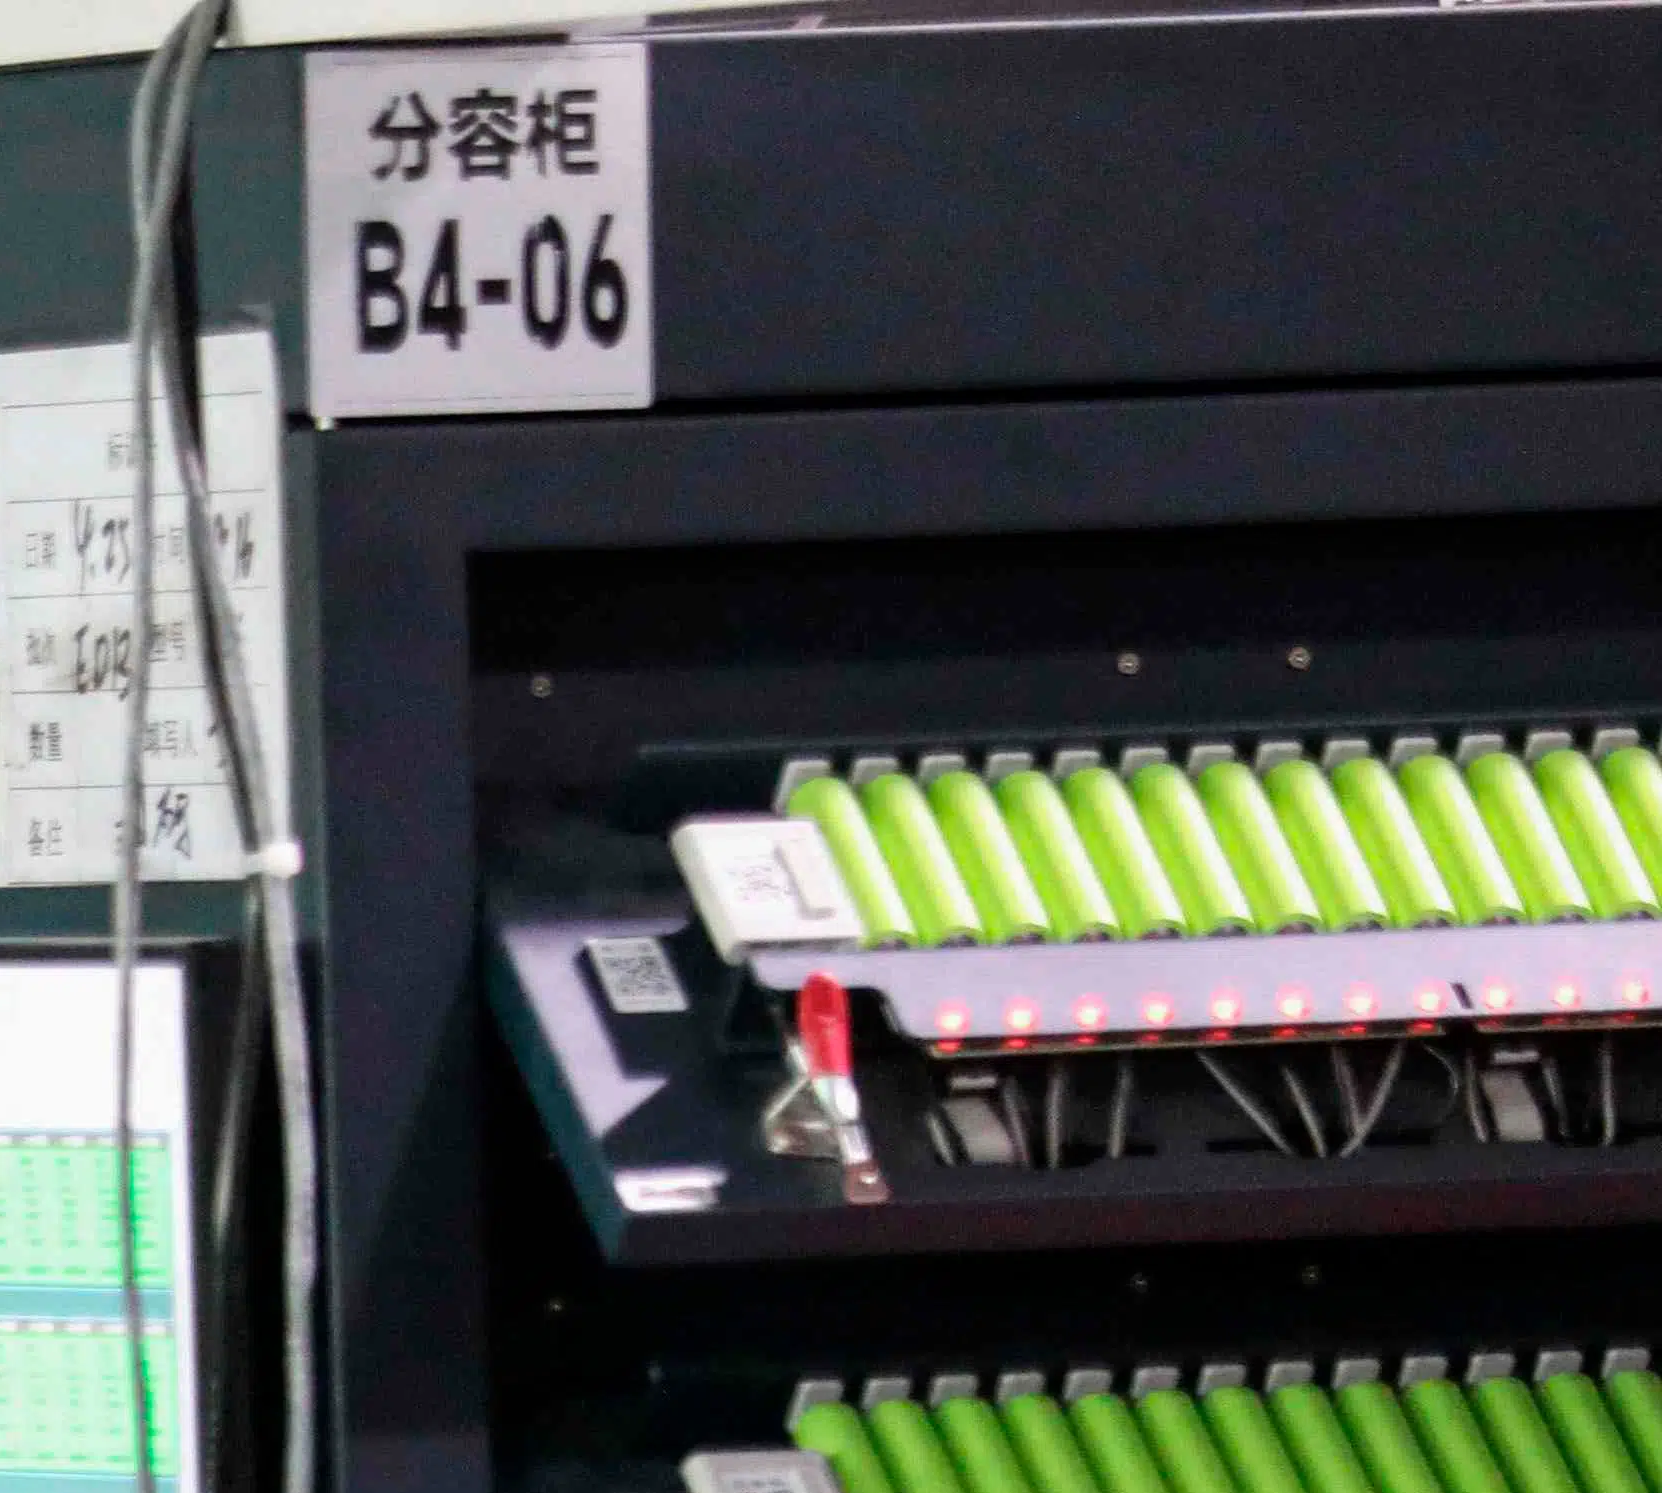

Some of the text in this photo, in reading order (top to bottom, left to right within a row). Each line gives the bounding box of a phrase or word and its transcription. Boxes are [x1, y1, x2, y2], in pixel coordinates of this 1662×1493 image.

[369, 88, 600, 182] 分容柜
[354, 214, 629, 353] B4-06
